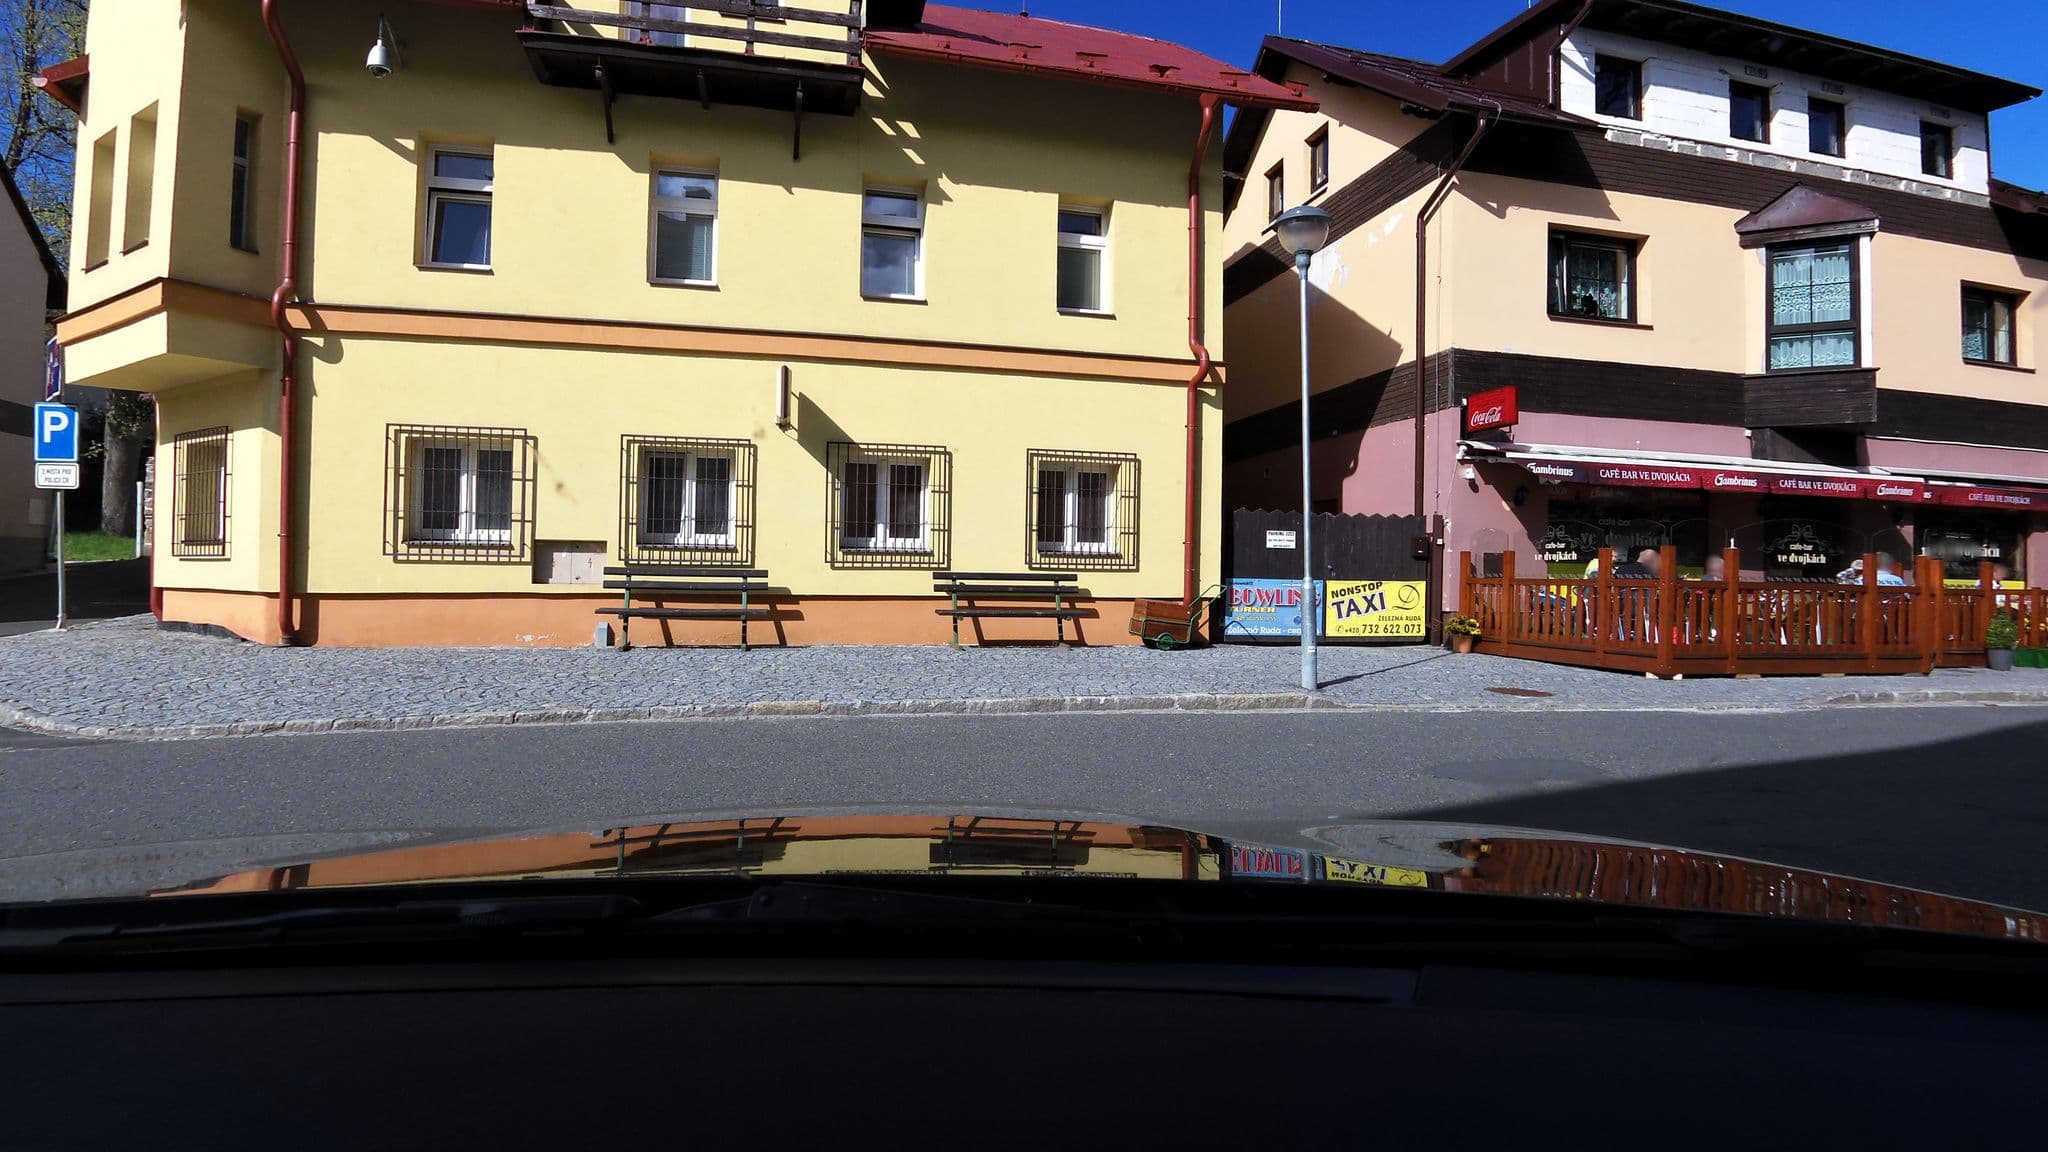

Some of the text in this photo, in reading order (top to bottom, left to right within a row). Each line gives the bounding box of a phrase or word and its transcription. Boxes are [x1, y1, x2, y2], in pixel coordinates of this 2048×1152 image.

[43, 411, 69, 443] P
[1527, 463, 1574, 476] Gambrinus
[1600, 468, 1690, 482] CAFÉ BAR VE DVOJKÁCH
[1714, 473, 1757, 487] Gambrinus
[1798, 480, 1811, 489] BAR
[1812, 481, 1822, 490] VE
[1543, 551, 1577, 562] dvojkách
[1777, 553, 1826, 565] ve dvojkách
[1331, 582, 1383, 599] NONSTOP
[1331, 592, 1387, 619] TAXI
[1260, 626, 1281, 634] Ruda
[1361, 624, 1379, 634] 732
[1383, 624, 1400, 634] 622
[1403, 624, 1421, 634] 073
